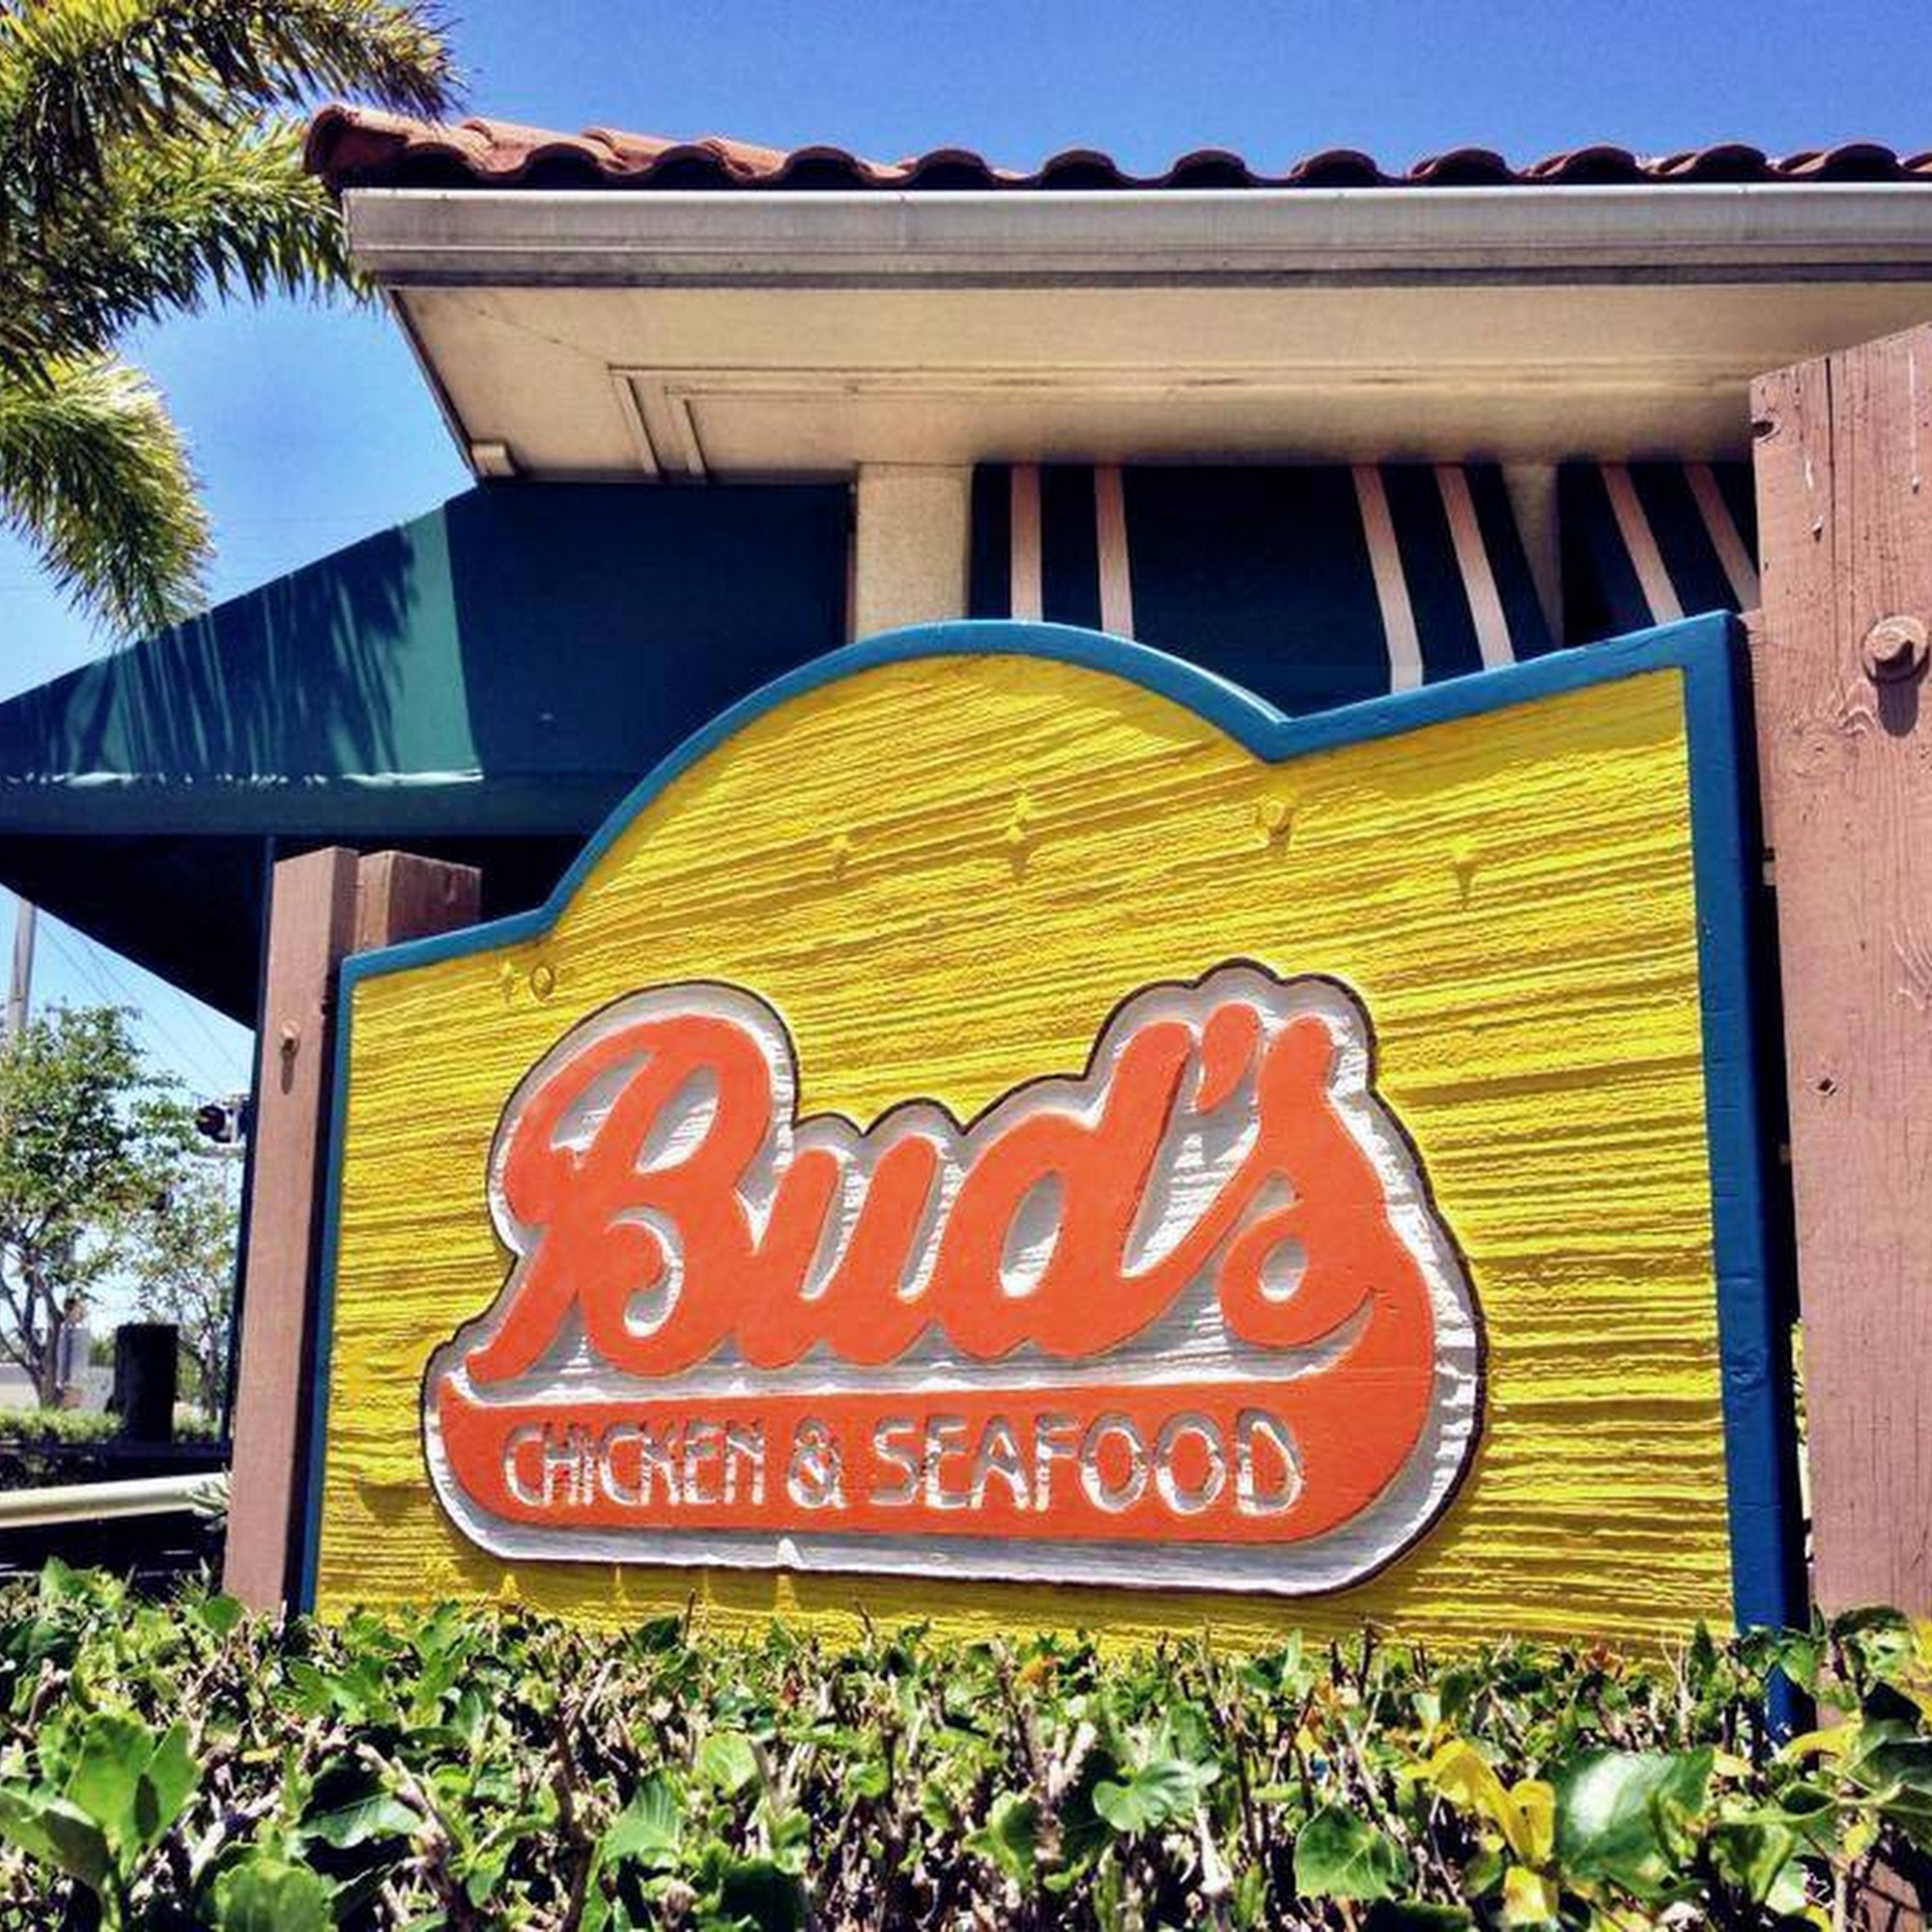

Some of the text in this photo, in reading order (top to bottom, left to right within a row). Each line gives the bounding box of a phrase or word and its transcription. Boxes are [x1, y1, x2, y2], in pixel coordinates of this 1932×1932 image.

[465, 1001, 1401, 1382] Bud's
[503, 1406, 1304, 1516] CHICKEN & SEAFOOD
